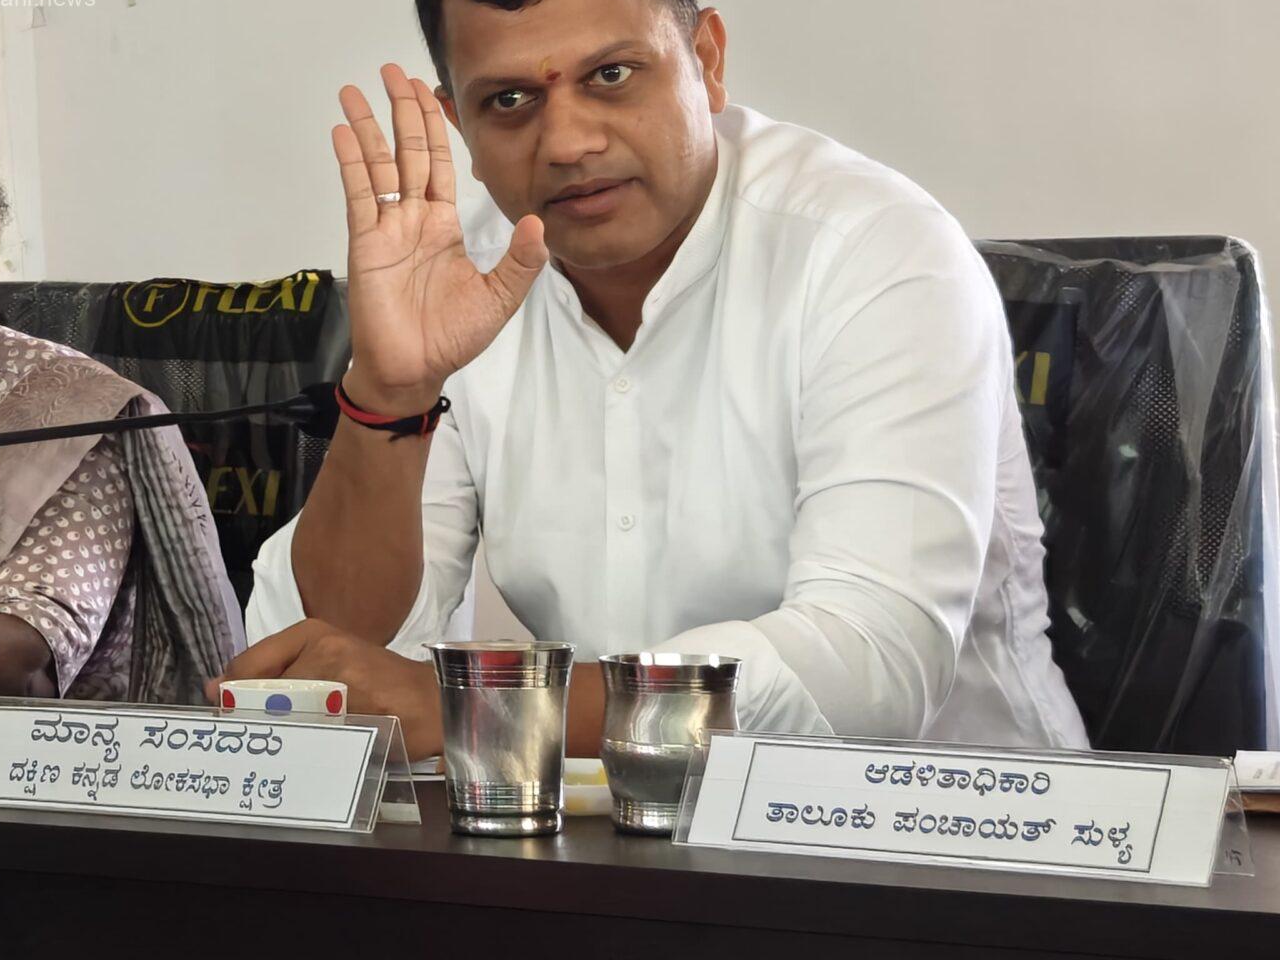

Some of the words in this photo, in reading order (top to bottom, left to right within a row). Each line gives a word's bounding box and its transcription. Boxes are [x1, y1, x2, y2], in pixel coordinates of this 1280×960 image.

[192, 272, 320, 314] FLEXI
[206, 466, 281, 517] EXI
[29, 713, 122, 763] ಮಾನ್ಯ
[138, 720, 284, 757] ಸಂಸದರು
[9, 758, 61, 797] ದಕ್ಷಿಣ
[71, 762, 122, 802] ಕನ್ನಡ
[130, 764, 232, 799] ಲೋಕಸಭಾ
[240, 771, 288, 811] ಕ್ಷೇತ್ರ
[865, 760, 1051, 797] ಆಡಳಿತಾಧಿಕಾರಿ
[766, 800, 876, 831] ತಾಲೂಕು
[893, 805, 1058, 842] ಪಂಚಾಯತ್
[1071, 820, 1134, 866] ಸುಳ್ಯ
